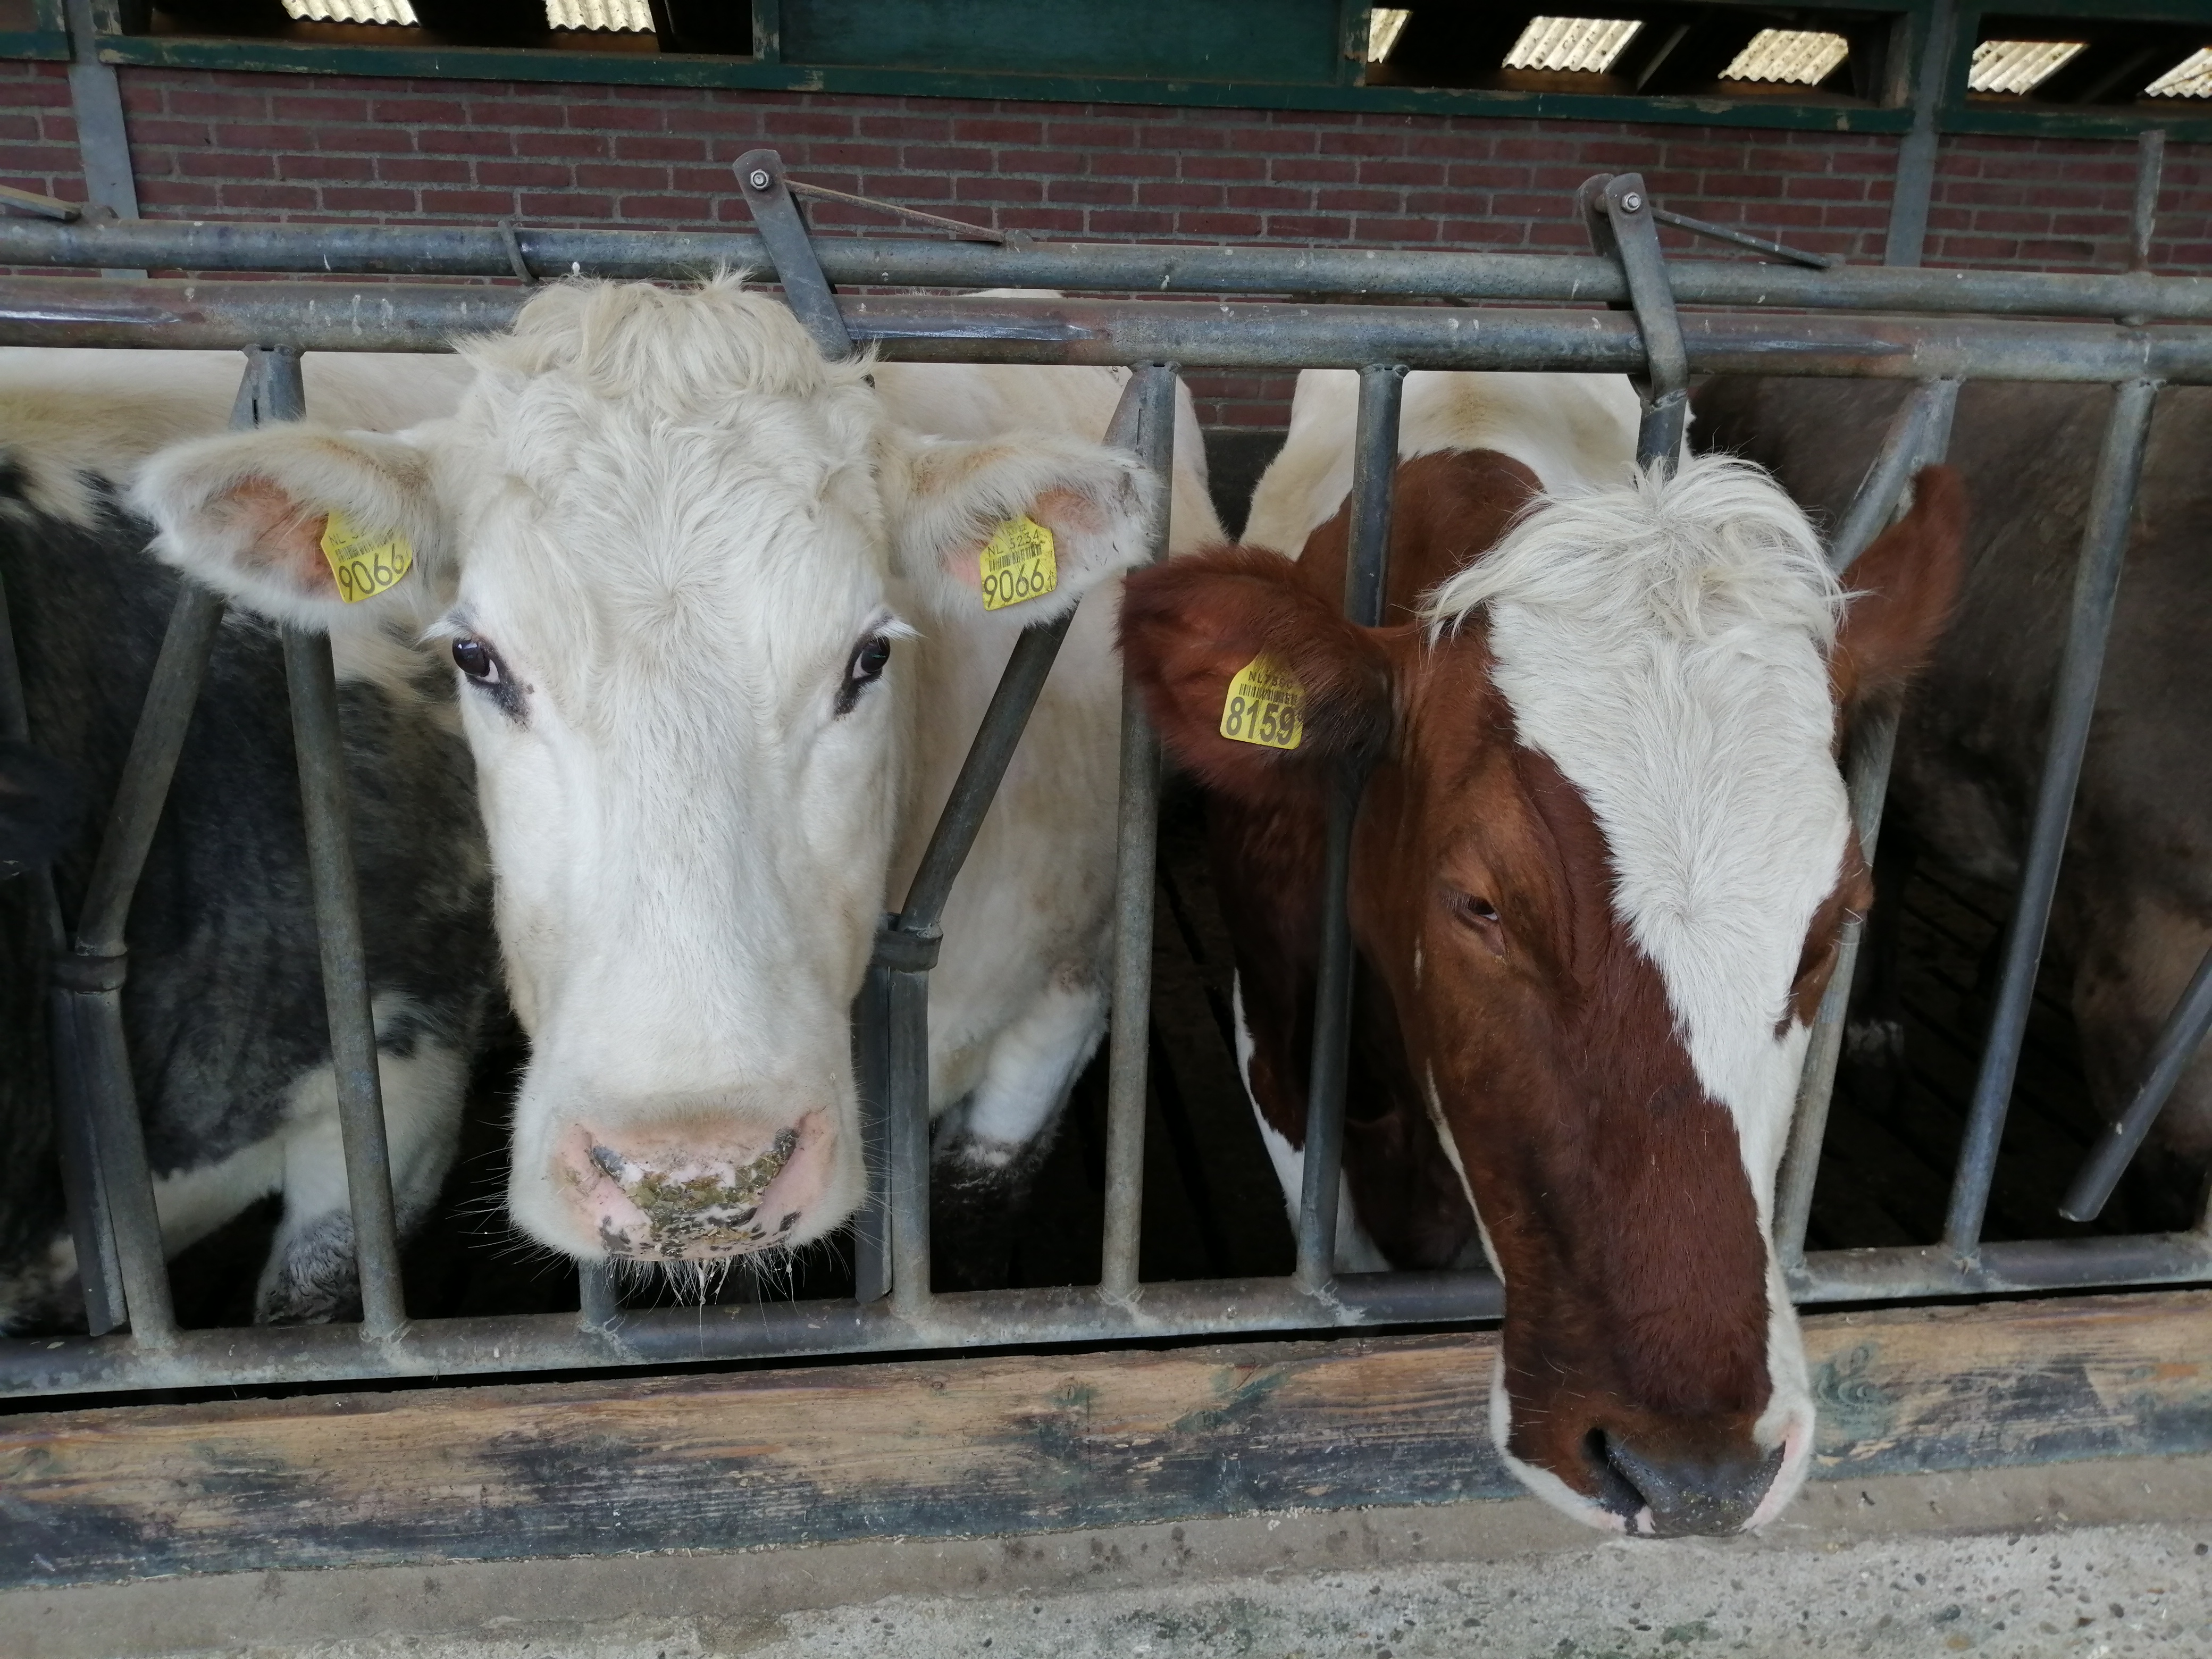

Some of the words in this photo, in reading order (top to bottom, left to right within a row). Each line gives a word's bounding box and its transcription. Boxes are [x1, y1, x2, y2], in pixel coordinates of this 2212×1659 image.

[328, 533, 346, 547] NL
[988, 544, 1003, 558] NL
[339, 543, 404, 601] 9066
[984, 558, 1044, 608] 9066
[1249, 671, 1262, 683] NL
[1226, 697, 1295, 745] 8159
